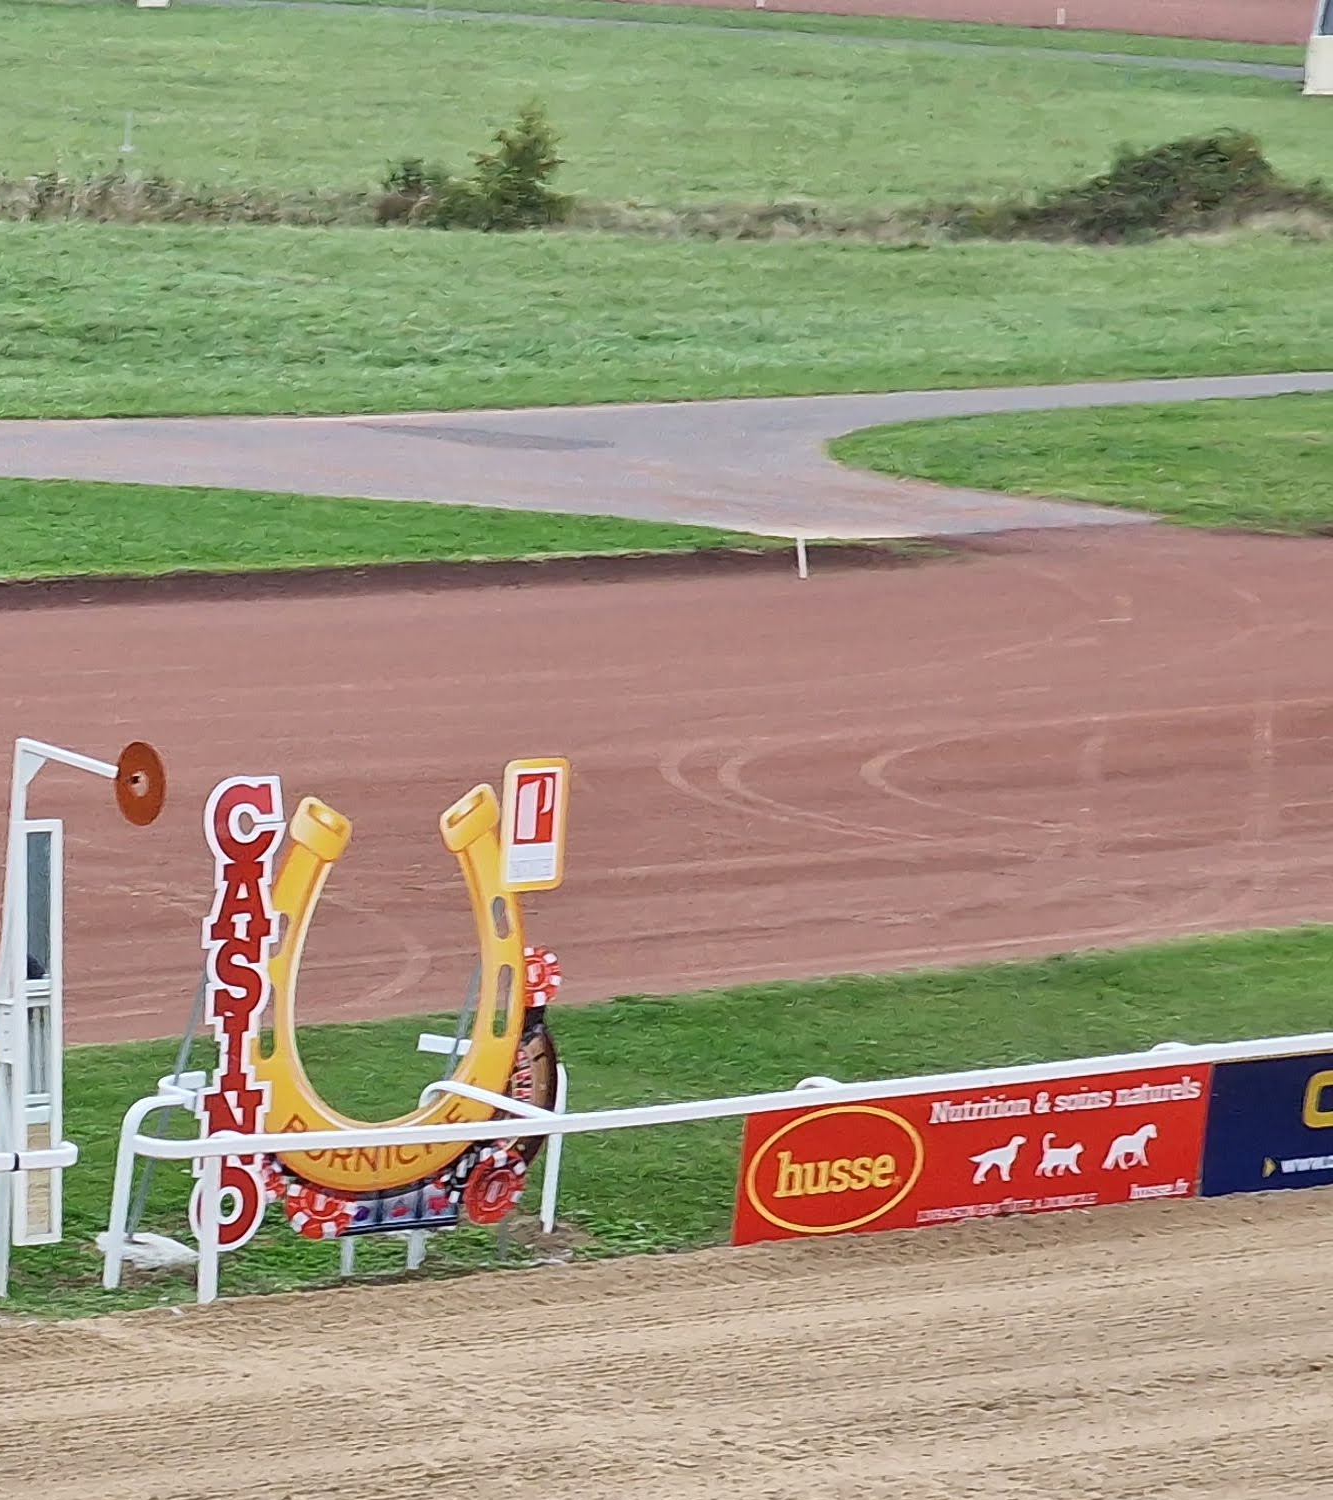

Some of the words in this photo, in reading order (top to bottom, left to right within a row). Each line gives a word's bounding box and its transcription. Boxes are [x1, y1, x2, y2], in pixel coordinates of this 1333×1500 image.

[929, 1095, 1031, 1124] Nutrition
[1034, 1091, 1051, 1114] &
[1053, 1087, 1113, 1112] soins
[1115, 1076, 1202, 1107] naturels
[772, 1150, 896, 1198] husse
